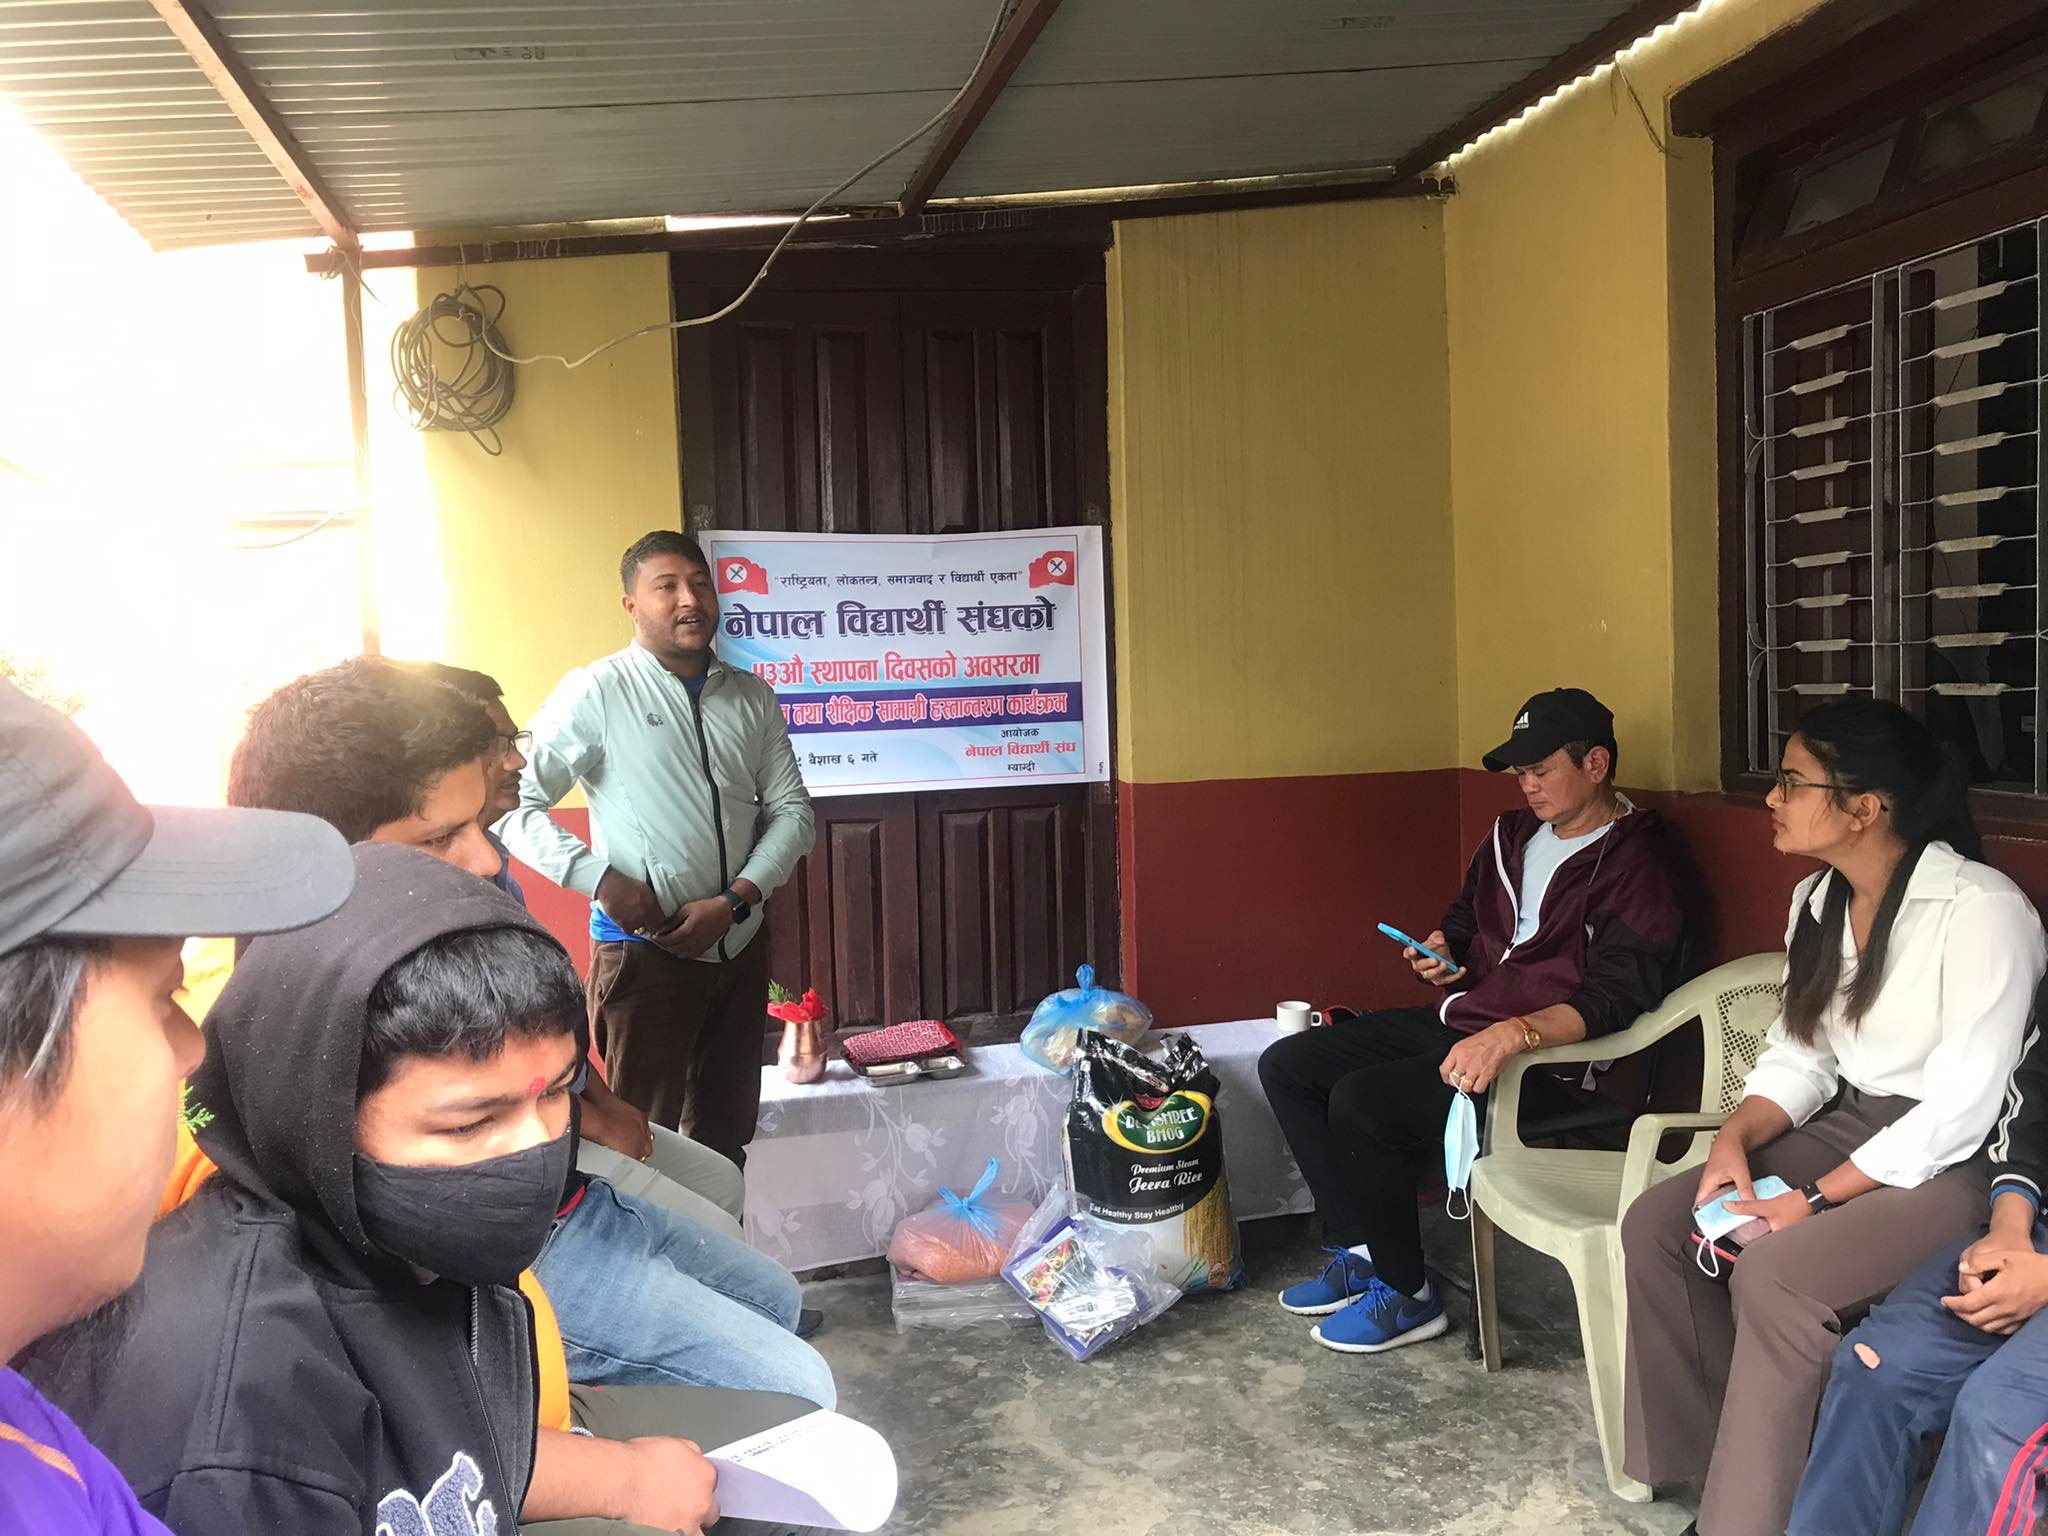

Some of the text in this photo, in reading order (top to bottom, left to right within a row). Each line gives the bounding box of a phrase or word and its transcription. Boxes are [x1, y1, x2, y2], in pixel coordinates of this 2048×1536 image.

[887, 573, 933, 586] समाजवाद
[938, 573, 946, 585] र
[950, 570, 985, 583] विद्यार्थी
[723, 595, 1057, 640] नेपाल विद्यार्थी संघको
[810, 658, 879, 685] स्थापना
[884, 649, 957, 682] दिवसको
[963, 653, 1041, 678] अवसरमा
[793, 703, 824, 726] तथा
[826, 695, 873, 725] शैक्षिक
[929, 695, 1005, 722] हस्तान्तरण
[1006, 688, 1068, 716] कार्यक्रम
[1001, 727, 1040, 738] आयोजक
[965, 739, 1076, 757] नेपाल विद्यार्थी संघ
[847, 753, 856, 765] ६
[860, 750, 878, 763] गते
[1146, 1126, 1185, 1144] BHOG
[1130, 1158, 1199, 1176] Premium Steam
[1129, 1171, 1203, 1194] Jeera Rice
[1102, 1208, 1132, 1220] Healthy
[1134, 1211, 1153, 1221] Stay
[1155, 1202, 1185, 1217] Healthy
